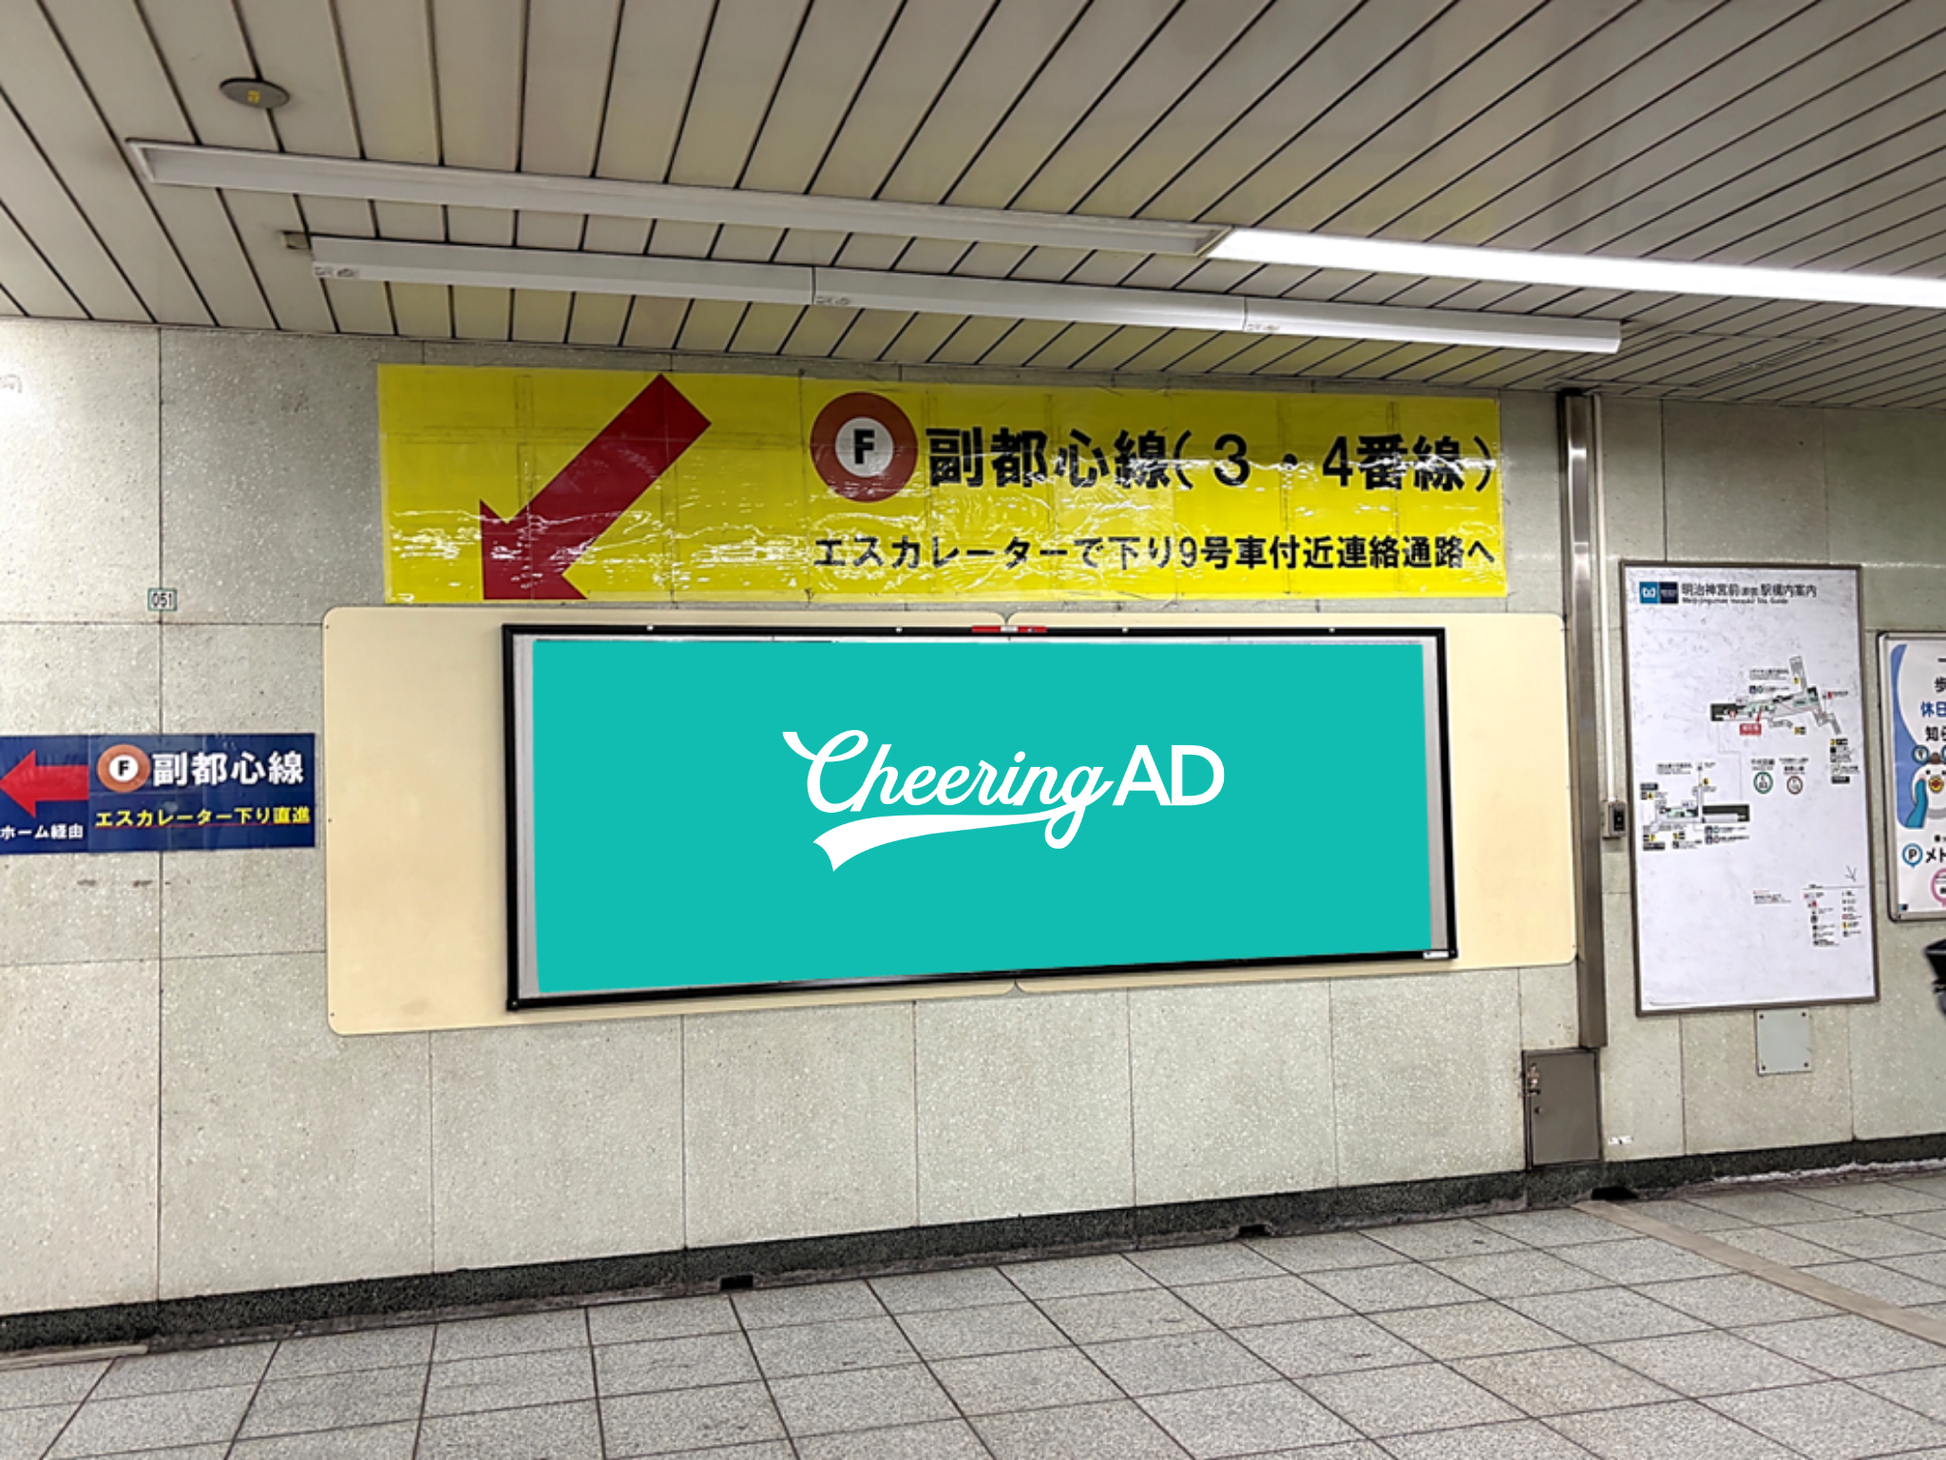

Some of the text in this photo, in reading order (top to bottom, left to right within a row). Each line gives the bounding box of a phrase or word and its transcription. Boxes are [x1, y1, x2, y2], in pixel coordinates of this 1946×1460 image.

[853, 428, 875, 465] F
[814, 535, 1496, 570] エスカレーターで下り9号車付近連絡通路へ
[151, 592, 172, 608] 051
[117, 760, 130, 776] F
[152, 750, 304, 787] 副都心線
[782, 729, 1225, 850] Cheering AD
[95, 806, 310, 828] エスカレーター下り直進
